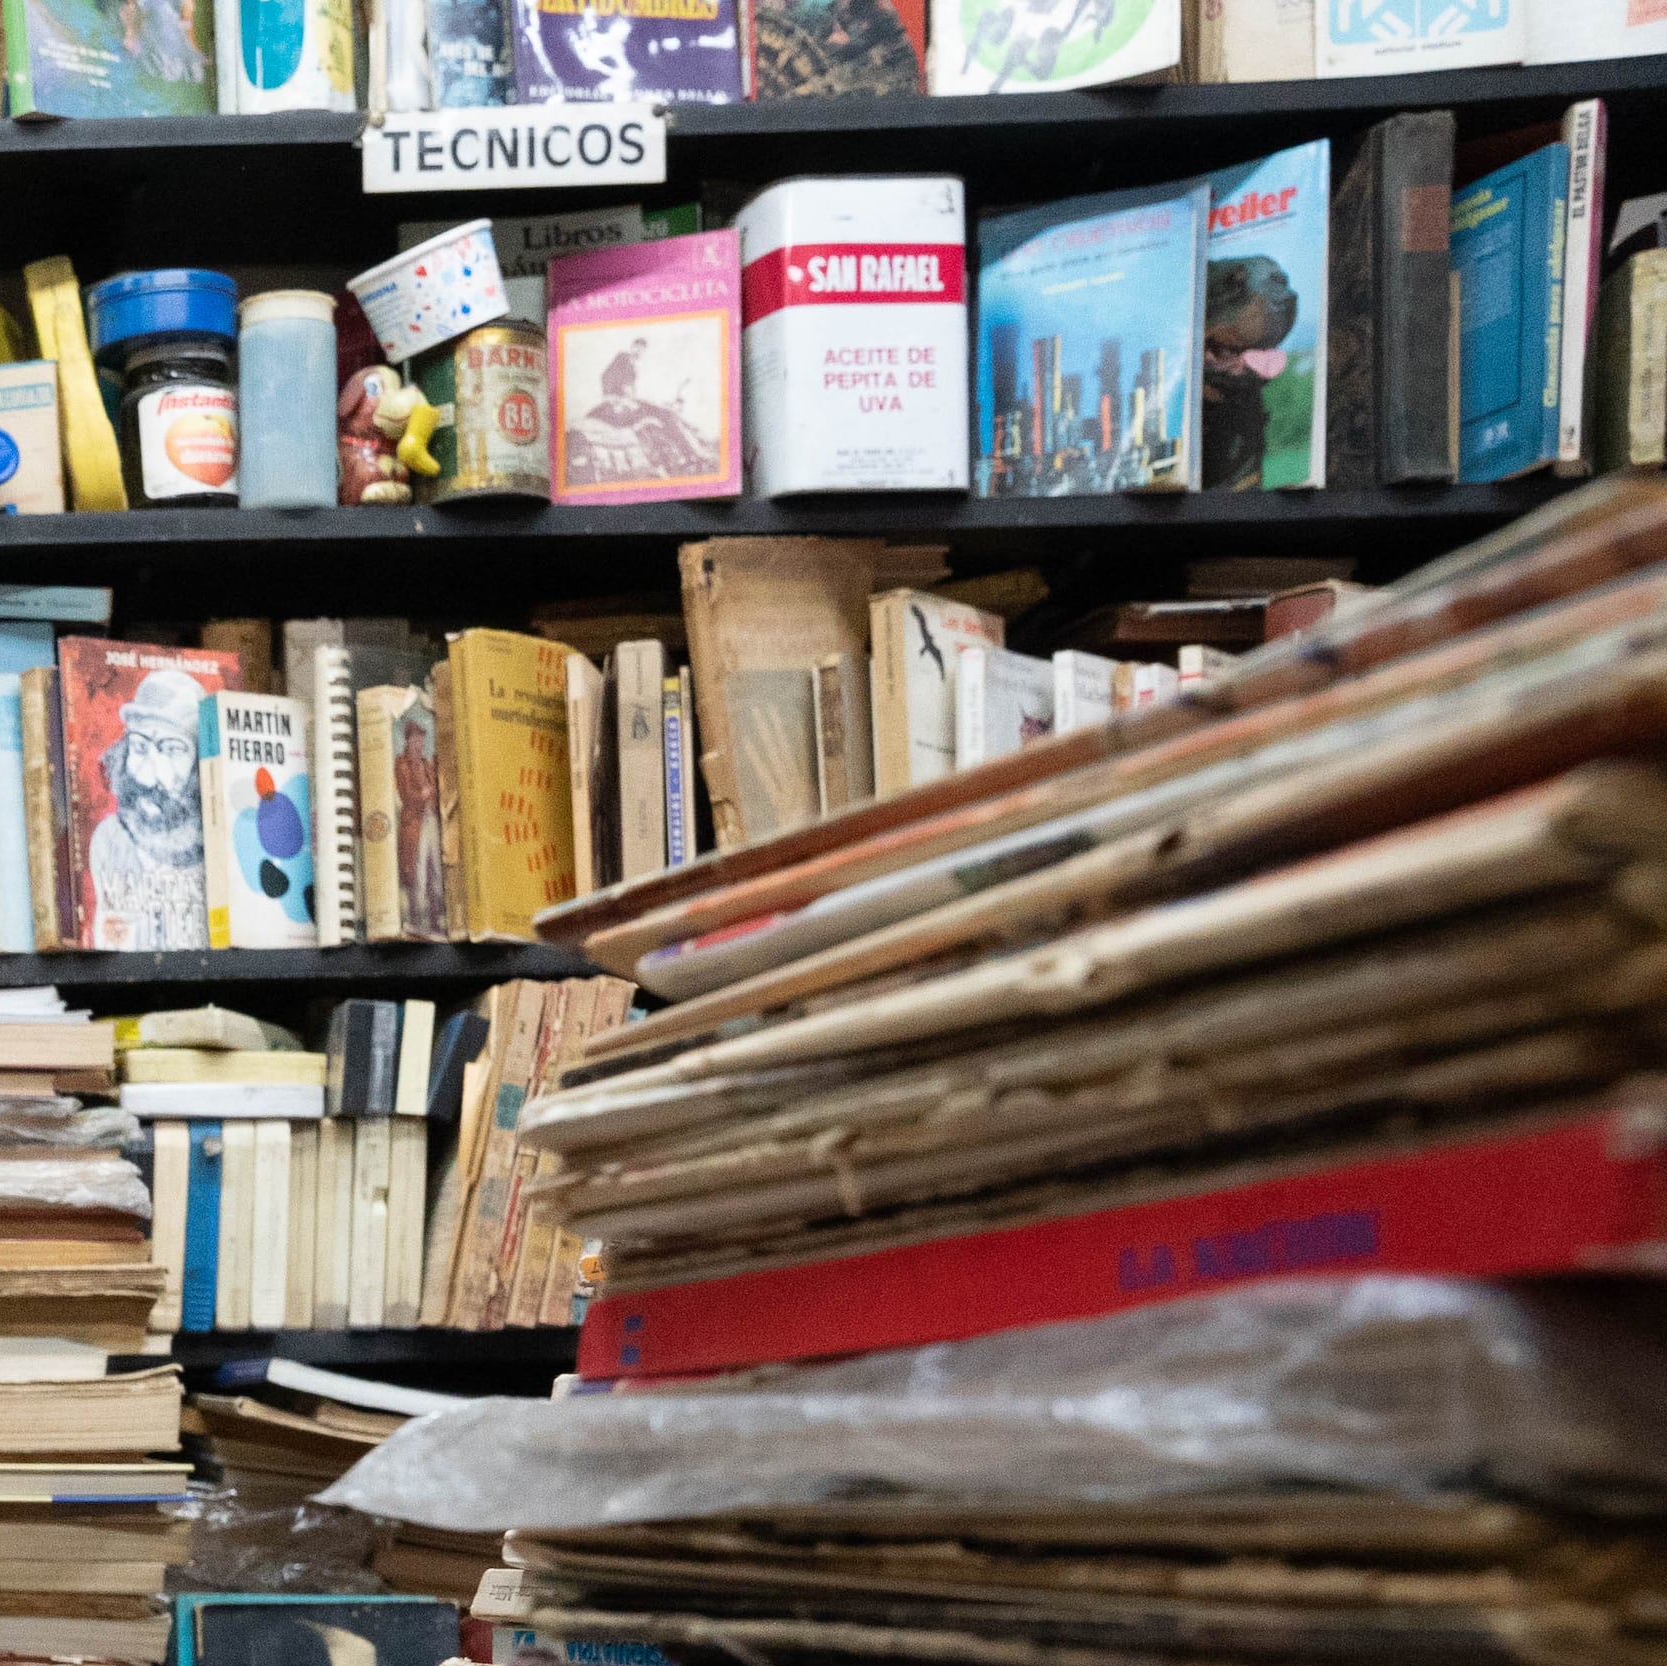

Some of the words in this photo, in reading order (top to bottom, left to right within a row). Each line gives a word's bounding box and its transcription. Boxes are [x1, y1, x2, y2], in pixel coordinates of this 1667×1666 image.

[382, 122, 646, 173] TECNICOS
[522, 219, 623, 249] Libros
[809, 256, 865, 293] SAN
[869, 254, 945, 292] RAFAEL
[824, 347, 901, 367] ACEITE
[907, 346, 936, 365] DE
[824, 371, 897, 390] PEPITA
[909, 370, 938, 389] DE
[859, 393, 905, 413] UVA
[226, 705, 292, 740] MARTÍN
[229, 737, 287, 767] FIERRO
